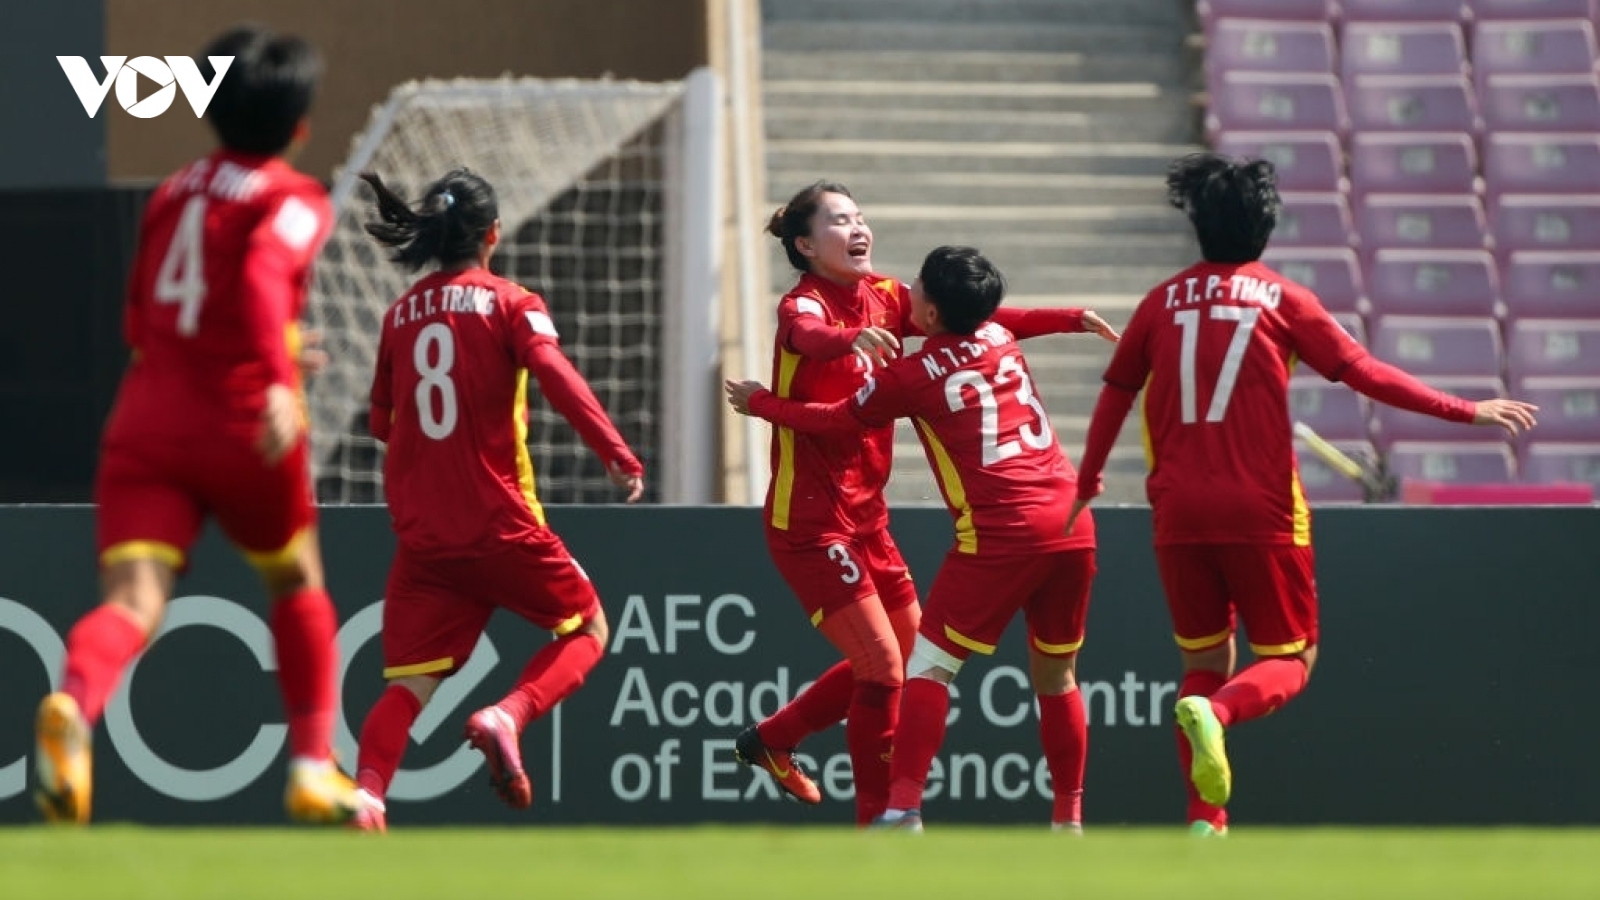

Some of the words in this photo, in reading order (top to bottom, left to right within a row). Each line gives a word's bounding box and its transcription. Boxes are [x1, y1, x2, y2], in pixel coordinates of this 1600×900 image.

[154, 195, 207, 336] 4
[1230, 275, 1282, 311] THAO
[441, 285, 496, 316] TRANG
[414, 322, 458, 440] 8
[1173, 305, 1262, 424] 17
[945, 355, 1053, 467] 23
[828, 543, 860, 584] 3
[611, 593, 757, 654] AFC
[610, 739, 681, 801] of
